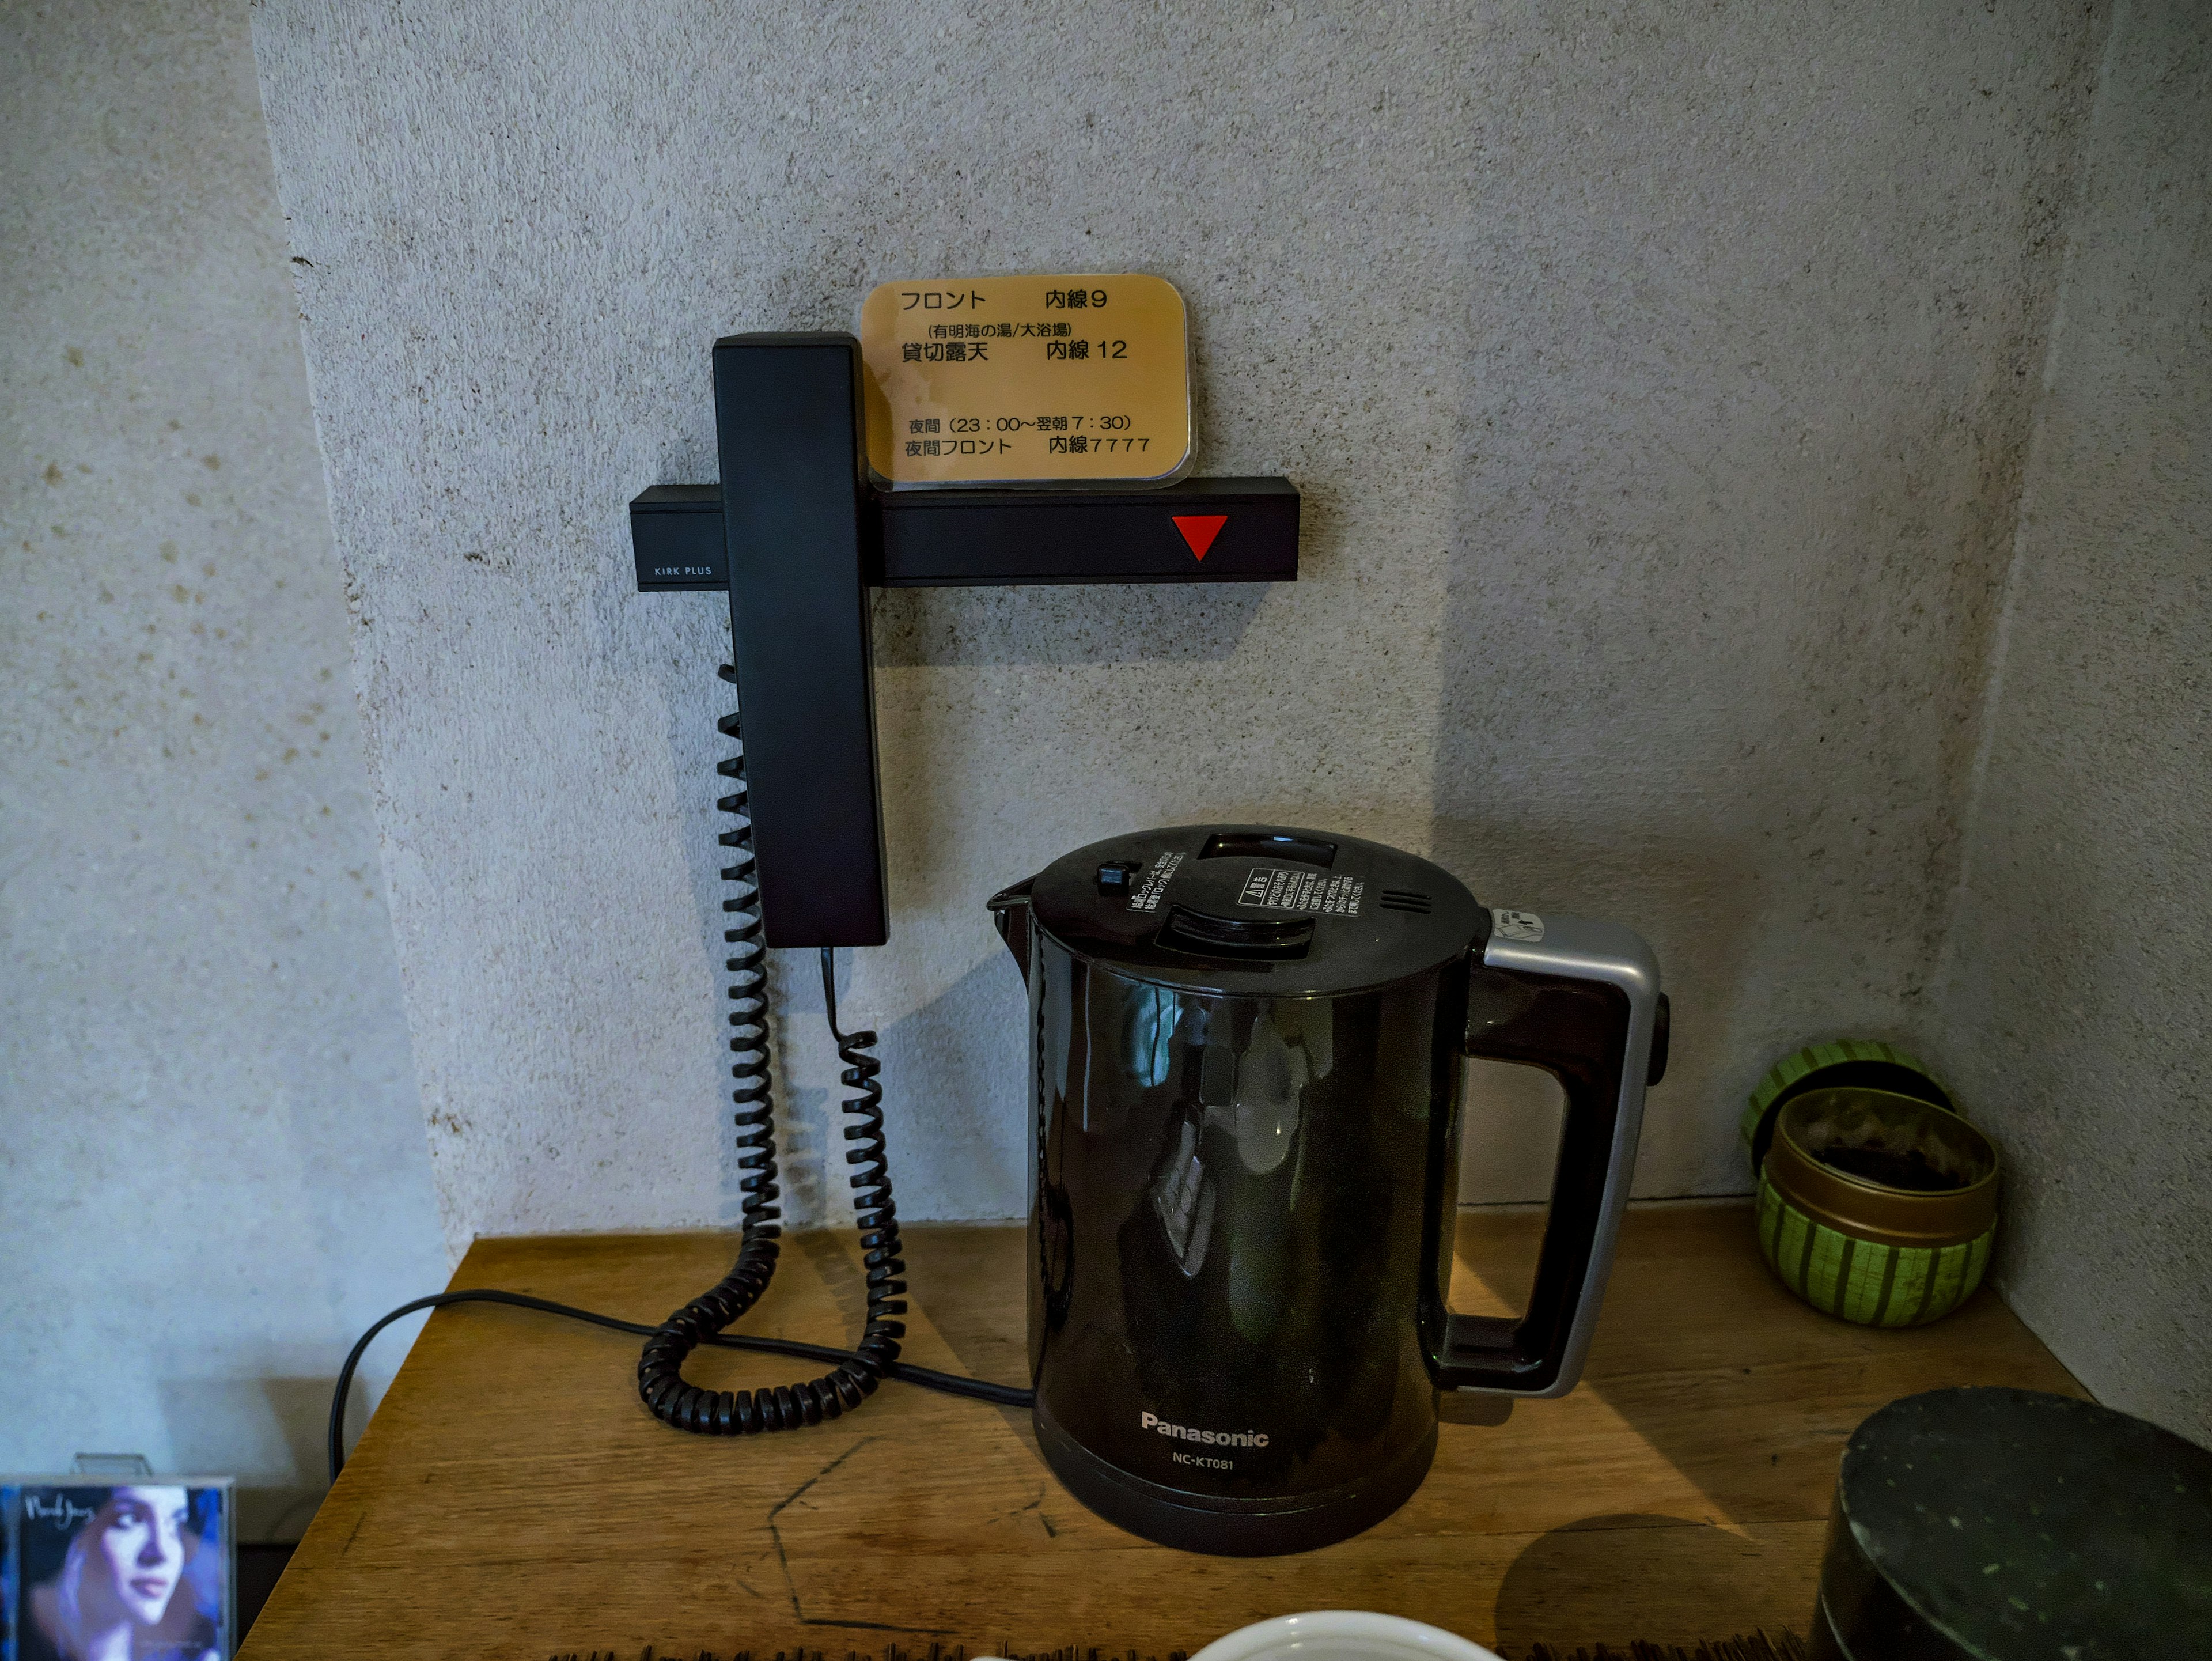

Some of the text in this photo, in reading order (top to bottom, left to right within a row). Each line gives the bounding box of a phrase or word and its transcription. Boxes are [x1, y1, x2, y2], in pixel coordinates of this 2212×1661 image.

[902, 289, 1107, 311] フロント 内線9
[928, 323, 1071, 339] (有明海の湯/大浴場)
[902, 342, 988, 362] 貸切露天
[905, 435, 1150, 457] 夜間フロント 内線7777
[654, 567, 712, 576] KIRK PLUS
[1141, 1411, 1270, 1447] Panasonic
[1173, 1452, 1233, 1470] NC-KT081
